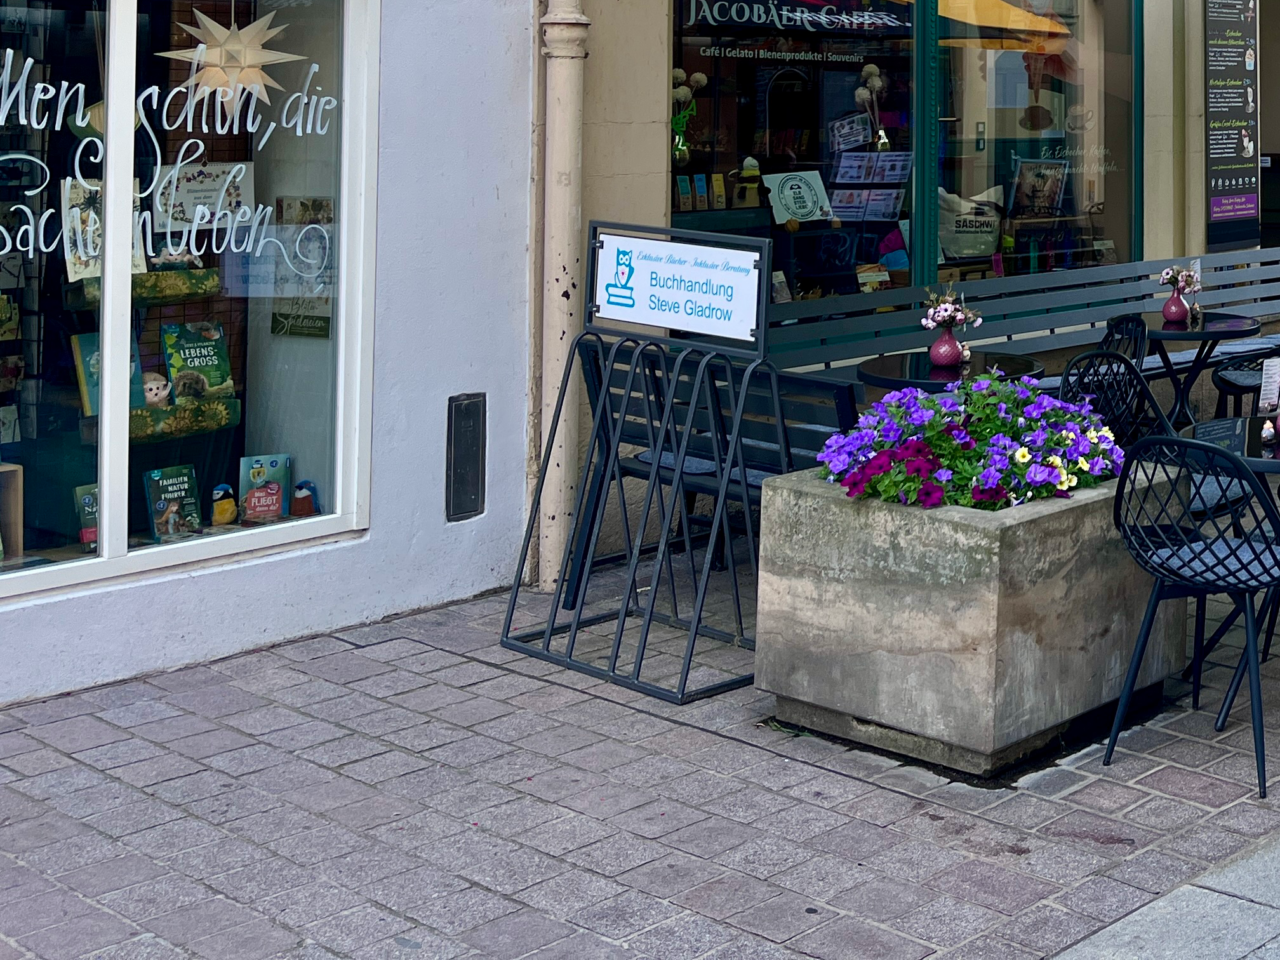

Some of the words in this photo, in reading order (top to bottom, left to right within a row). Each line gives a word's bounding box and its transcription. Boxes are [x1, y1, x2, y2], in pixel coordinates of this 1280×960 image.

[700, 46, 720, 57] Café
[725, 47, 754, 58] Gelato
[759, 49, 822, 62] Bienenprodukte
[827, 52, 864, 62] Souvenirs
[281, 63, 337, 136] die
[665, 254, 688, 266] Bücher
[720, 261, 751, 276] Beratung
[650, 271, 733, 302] Buchhandlung
[649, 294, 680, 314] Steve
[684, 299, 733, 321] Gladrow
[180, 347, 218, 358] LEBENS-
[187, 356, 218, 367] GROSS
[159, 476, 188, 486] FAMILIEN
[251, 496, 278, 507] FLIEGT
